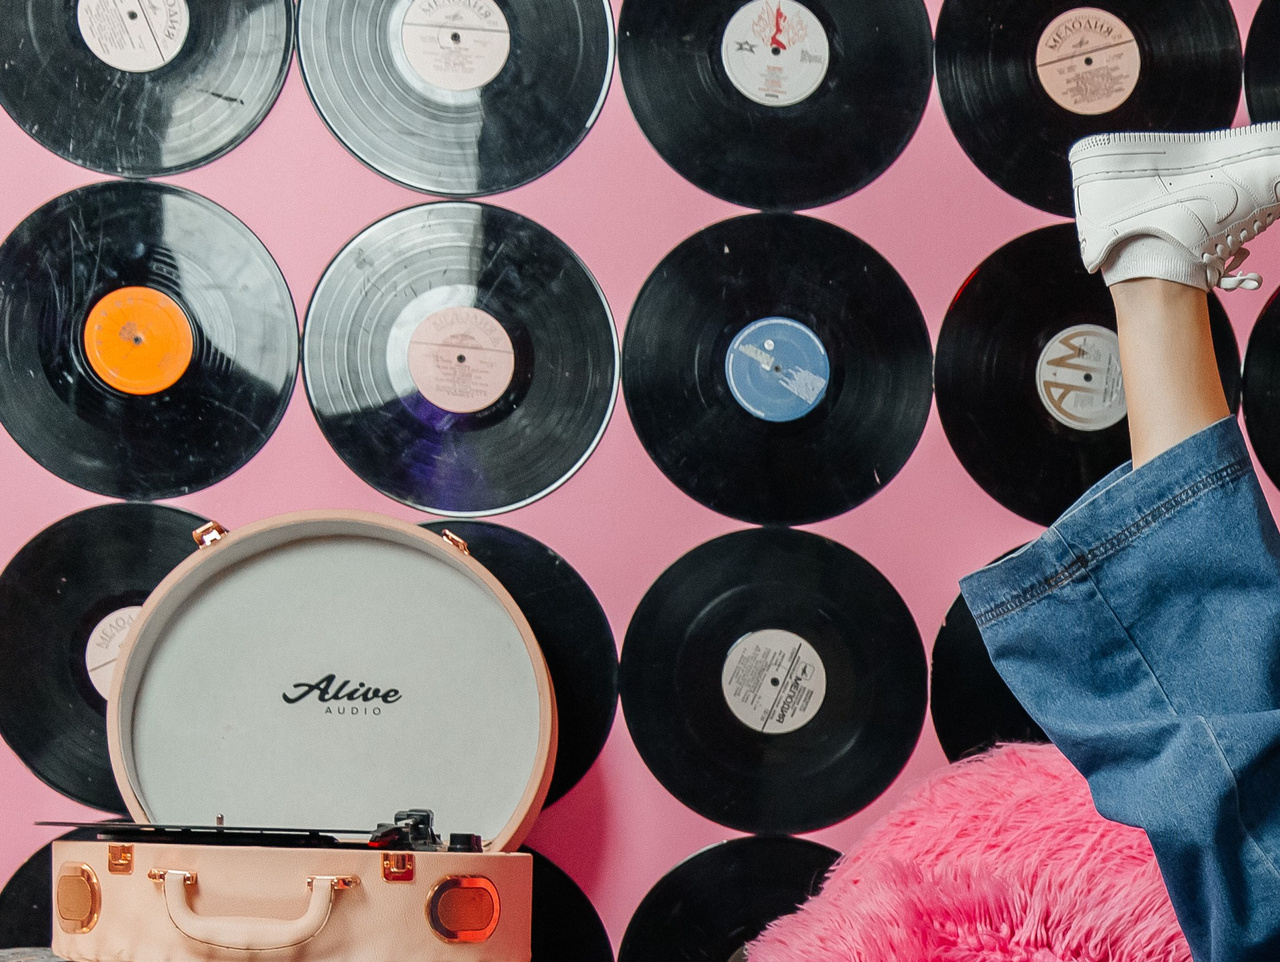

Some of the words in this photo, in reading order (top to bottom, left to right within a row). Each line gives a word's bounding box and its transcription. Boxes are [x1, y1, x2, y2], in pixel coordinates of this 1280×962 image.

[1045, 19, 1114, 50] МЕЛОДИЯ
[282, 673, 402, 704] Alive
[776, 676, 803, 724] МЕЛОДИЯ
[325, 706, 381, 716] AUDIO
